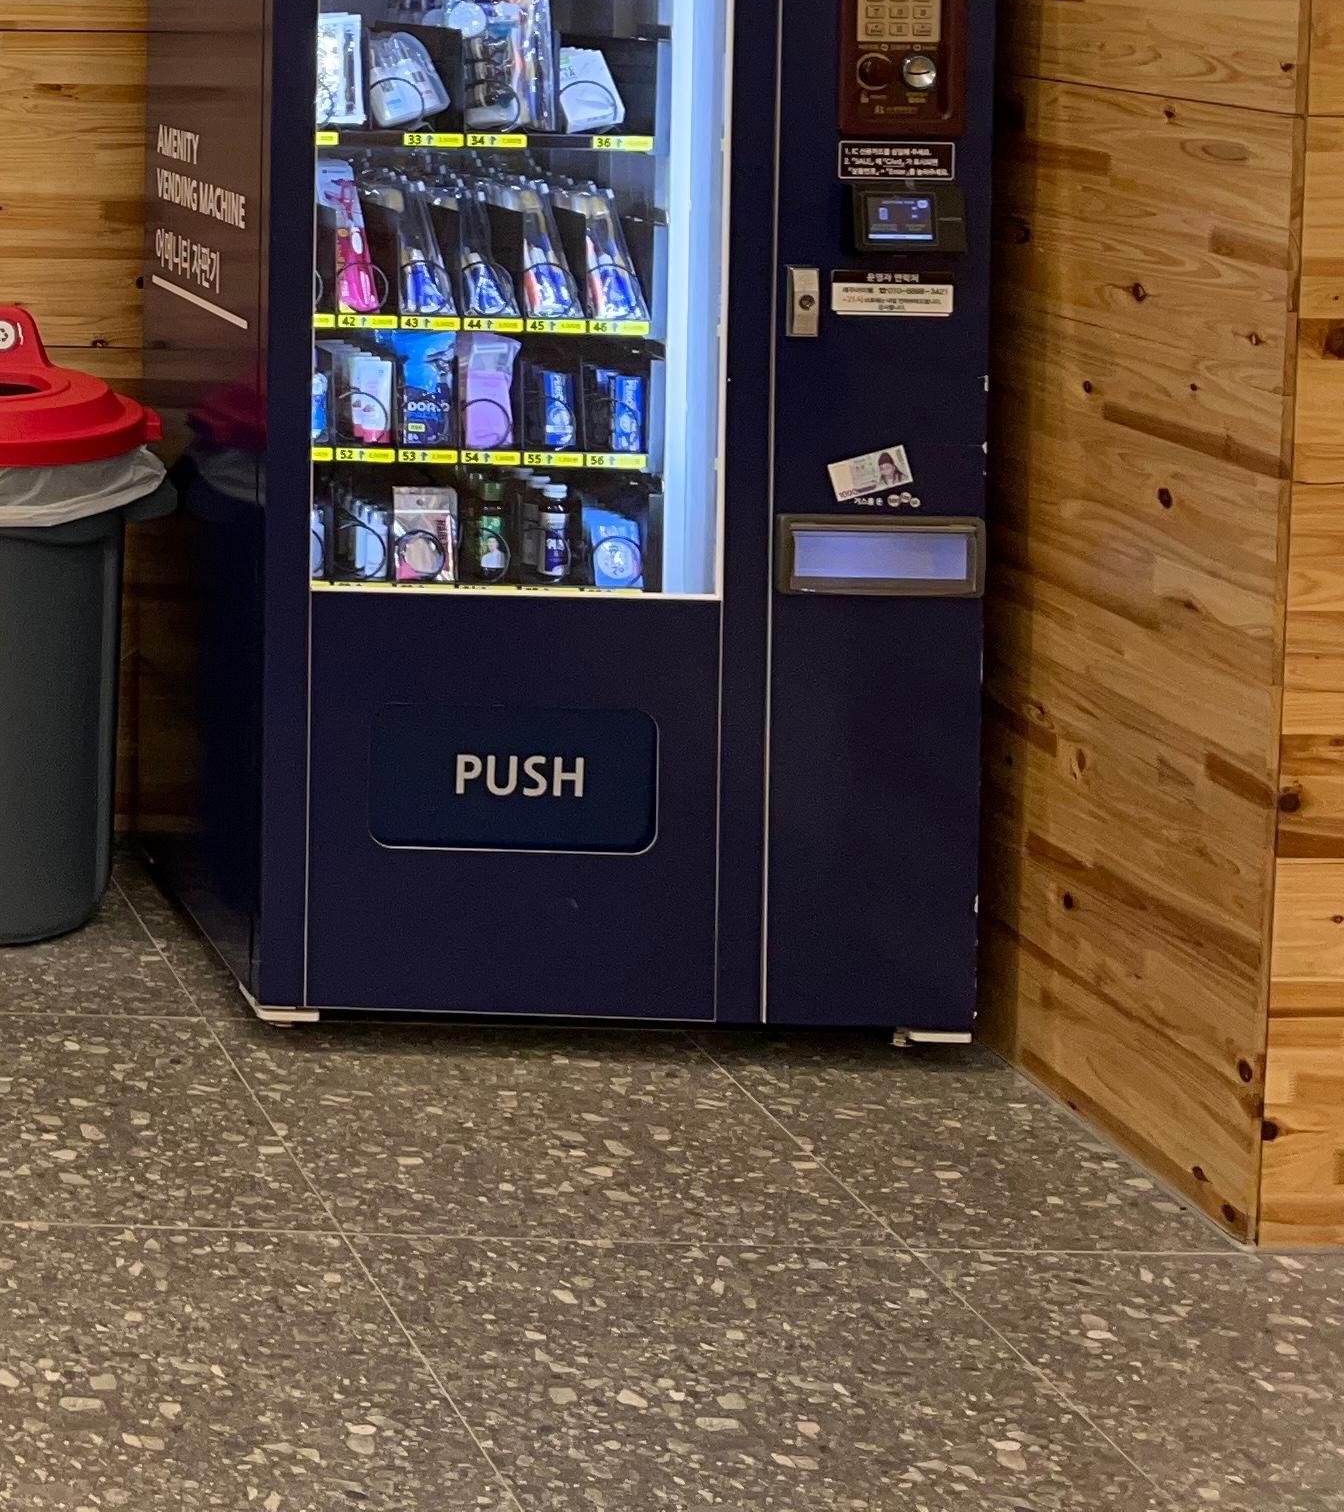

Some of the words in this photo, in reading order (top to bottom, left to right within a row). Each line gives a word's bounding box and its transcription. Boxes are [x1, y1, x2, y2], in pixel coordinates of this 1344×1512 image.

[157, 124, 199, 165] AMENITY
[409, 135, 421, 145] 33
[472, 136, 485, 145] 34
[597, 138, 610, 150] 36
[157, 168, 197, 211] VENDING
[199, 181, 246, 229] MACHINE
[155, 228, 190, 279] 어메니티
[192, 243, 220, 294] 자판기
[342, 317, 355, 326] 42
[405, 318, 418, 329] 43
[468, 320, 481, 329] 44
[530, 321, 544, 332] 45
[593, 322, 607, 331] 46
[340, 450, 353, 461] 52
[403, 451, 416, 462] 53
[465, 453, 479, 462] 54
[528, 454, 541, 465] 55
[591, 456, 604, 467] 56
[454, 754, 585, 798] PUSH
